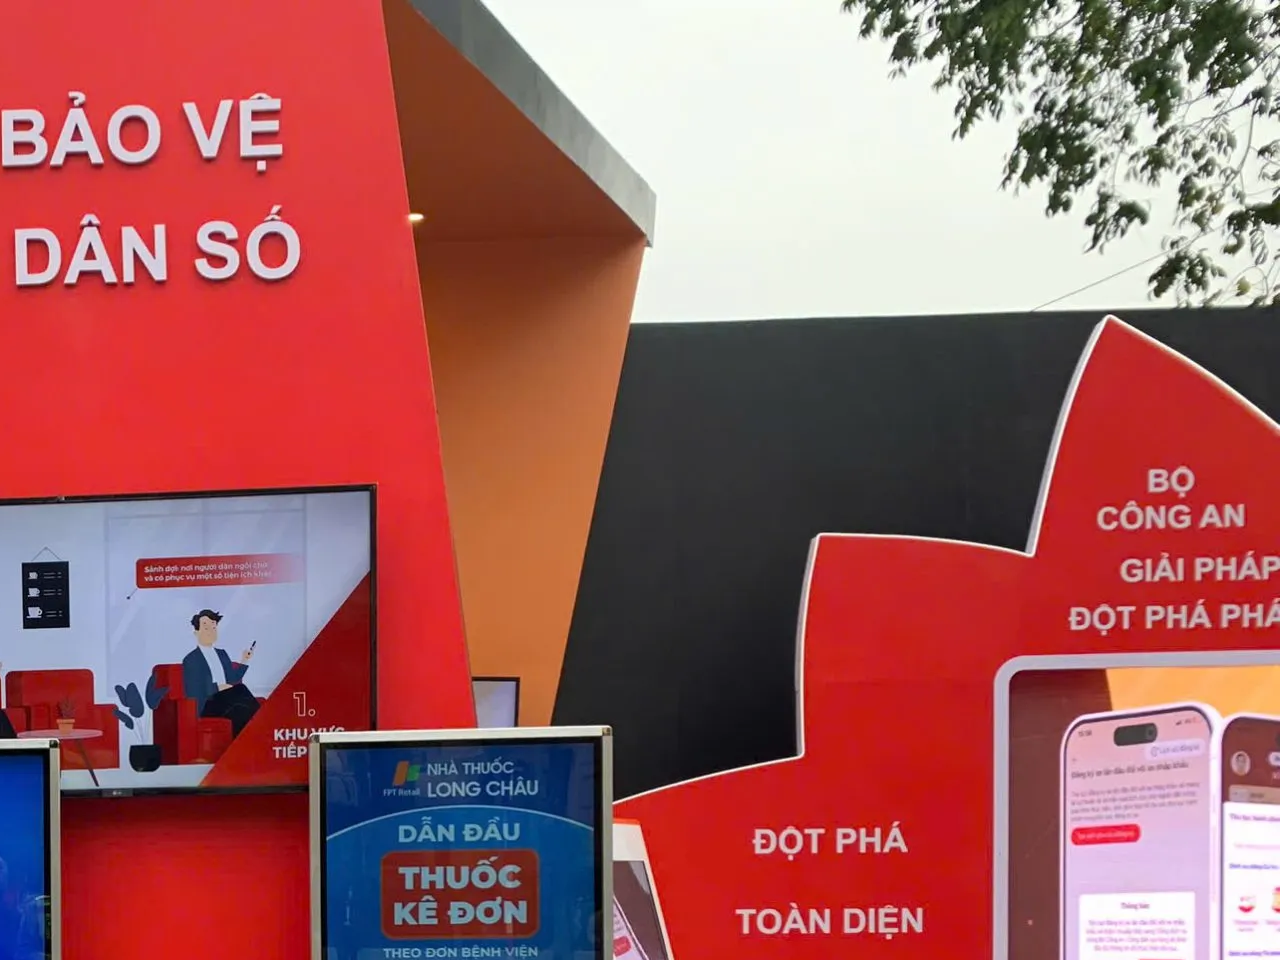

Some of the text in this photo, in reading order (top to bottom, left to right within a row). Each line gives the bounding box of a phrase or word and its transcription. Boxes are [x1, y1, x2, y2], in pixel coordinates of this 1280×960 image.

[1, 91, 162, 168] BẢO
[182, 92, 284, 172] VỆ
[14, 214, 167, 286] DÂN
[194, 205, 301, 280] SỐ
[1147, 465, 1195, 498] BỘ
[1096, 500, 1245, 531] CÔNG AN
[1120, 551, 1280, 583] GIẢI PHÁP
[1068, 603, 1136, 636] ĐỘT
[1145, 599, 1212, 629] PHÁ
[272, 741, 308, 759] TIẾP
[274, 728, 308, 741] KHU
[427, 756, 514, 776] NHÀ THUỐC
[383, 788, 396, 796] FPT
[427, 776, 539, 798] LONG CHÂU
[398, 816, 520, 843] DẪN ĐẦU
[752, 821, 908, 861] ĐỘT PHÁ
[398, 856, 522, 890] THUỐC
[393, 895, 527, 926] KÊ ĐƠN
[735, 903, 923, 940] TOÀN DIỆN
[383, 944, 538, 958] THEO ĐƠN BỆNH VIỆN
